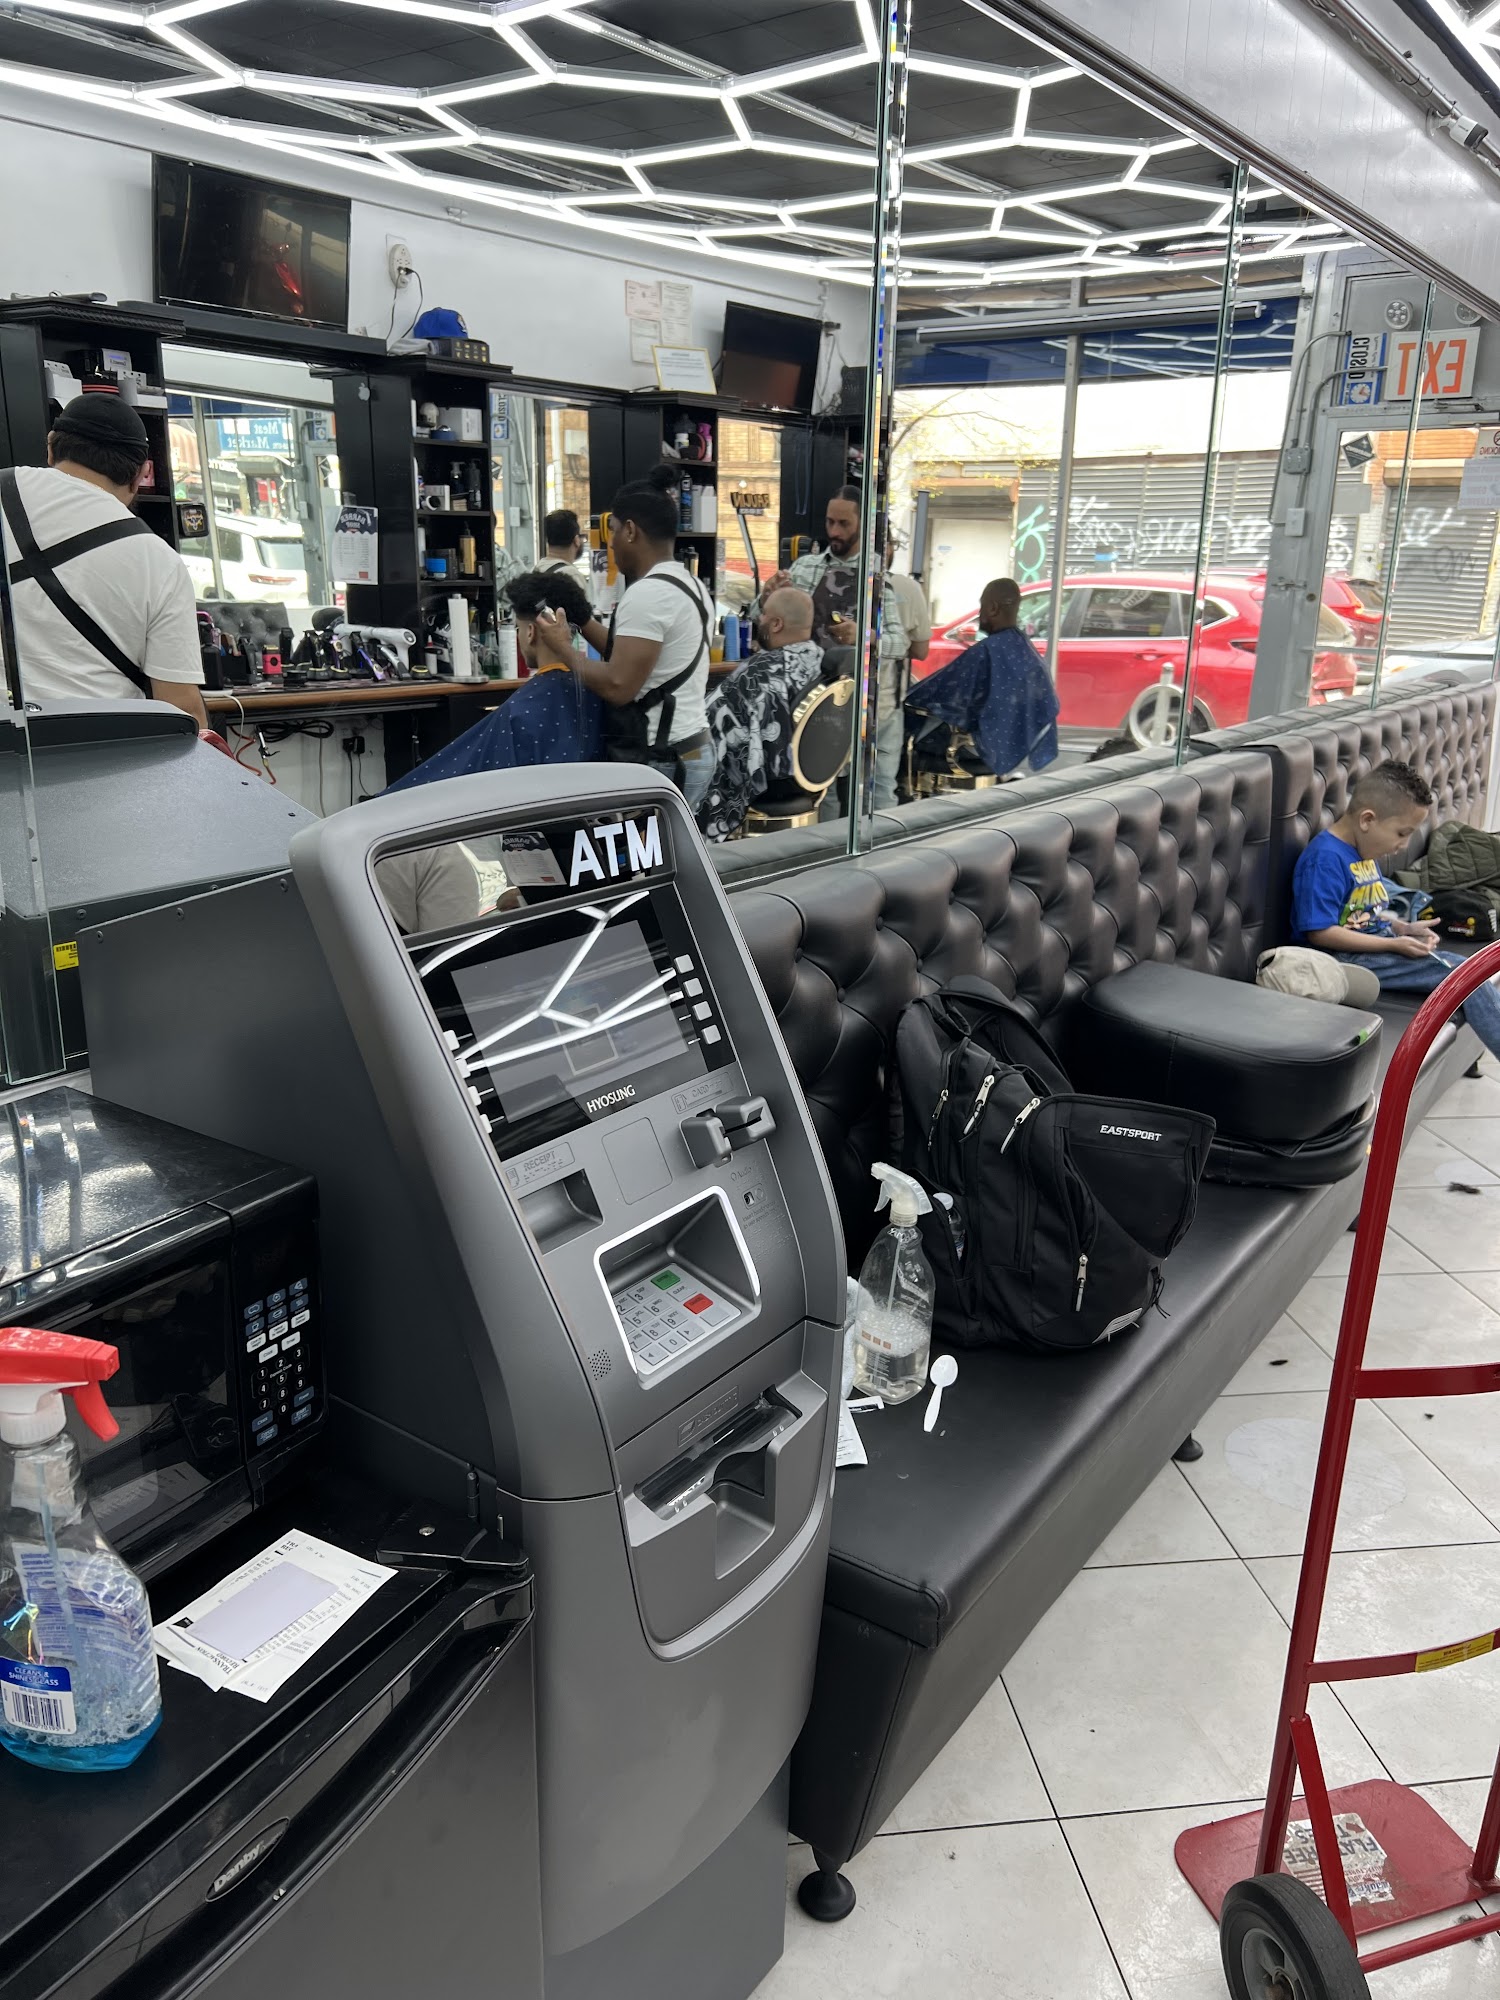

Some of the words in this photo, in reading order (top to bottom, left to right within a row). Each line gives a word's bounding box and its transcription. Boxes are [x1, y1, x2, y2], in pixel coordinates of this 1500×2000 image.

[569, 815, 664, 887] ATM
[586, 1084, 636, 1113] HYOSUNG
[1099, 1124, 1162, 1142] EASTSPORT
[523, 1150, 556, 1171] RECEIPT
[634, 1293, 644, 1301] 3
[616, 1304, 626, 1312] 2
[651, 1305, 660, 1313] 6
[667, 1318, 676, 1326] 9
[649, 1329, 659, 1337] 8
[630, 1341, 639, 1349] 7
[669, 1338, 678, 1346] 0
[296, 1349, 301, 1357] 3
[279, 1359, 283, 1367] 2
[298, 1364, 302, 1372] 6
[280, 1375, 284, 1383] 5
[298, 1379, 303, 1387] 9
[281, 1390, 285, 1398] 8
[262, 1400, 267, 1408] 7
[197, 1646, 233, 1675] TRANSACTION
[216, 1652, 240, 1669] RECORD
[14, 1666, 42, 1676] CLEANS
[8, 1672, 33, 1683] SHINES
[34, 1677, 59, 1686] GLASS
[1284, 1846, 1319, 1864] REE
[213, 1841, 262, 1892] Danby
